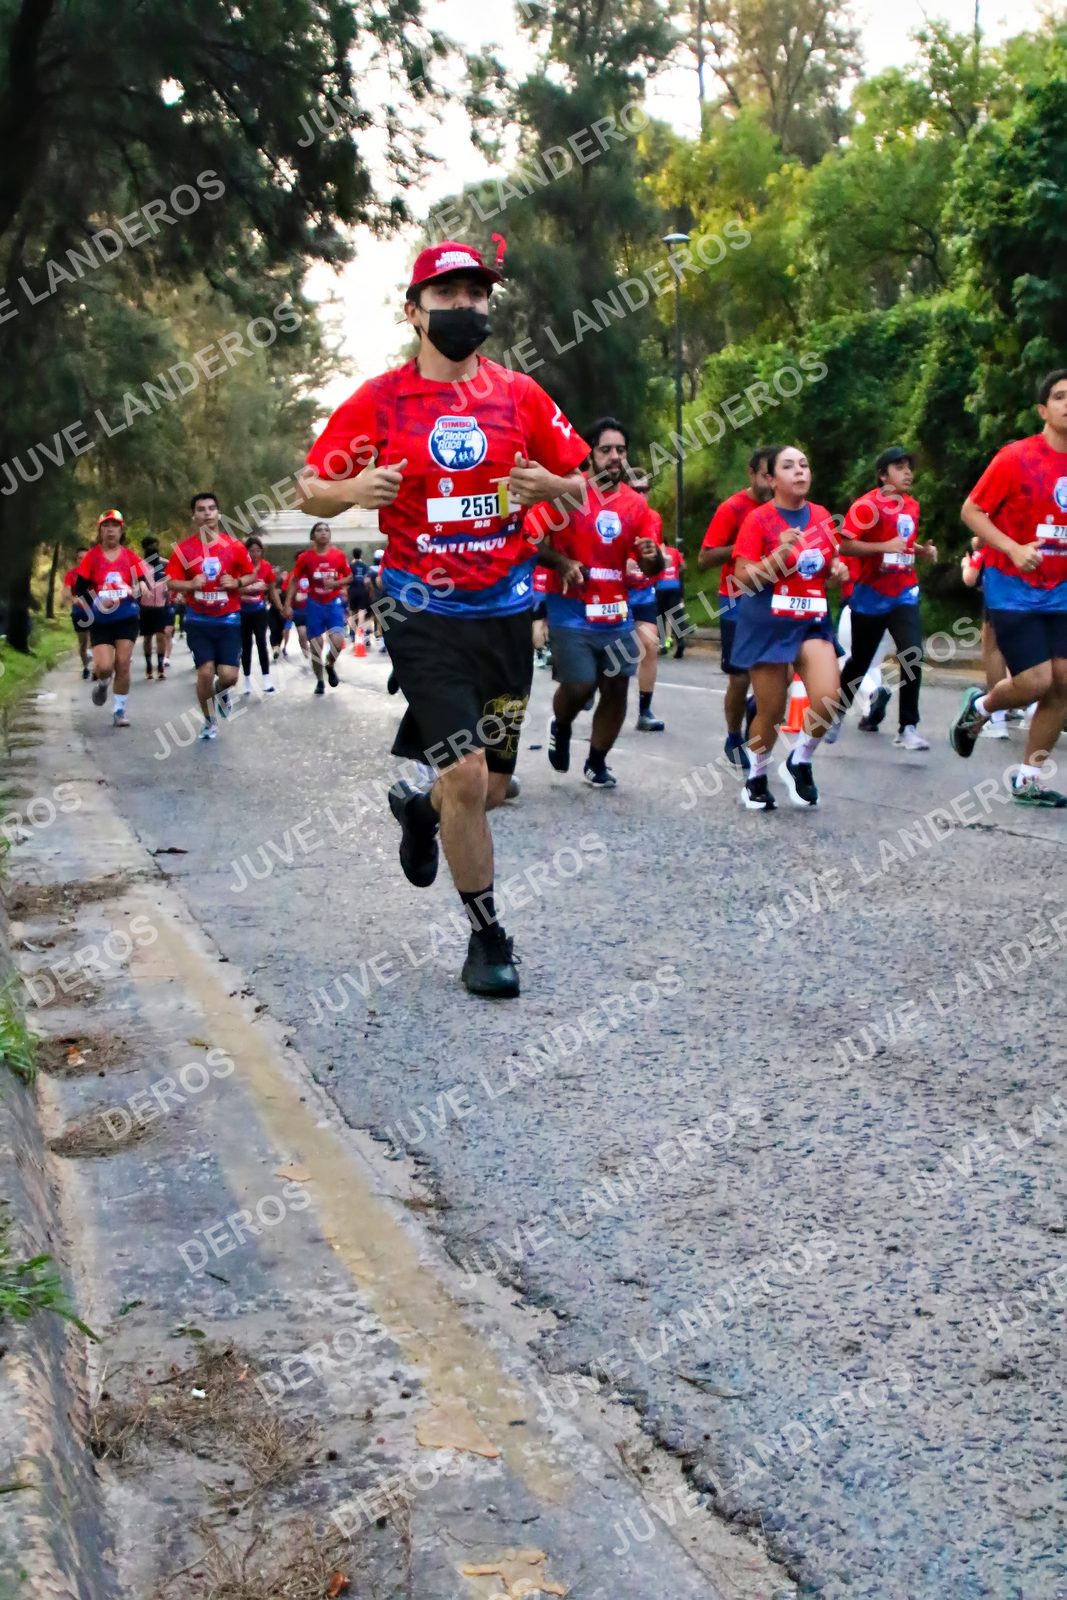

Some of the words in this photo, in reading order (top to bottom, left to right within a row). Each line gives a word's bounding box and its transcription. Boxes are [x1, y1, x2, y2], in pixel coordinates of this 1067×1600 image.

[441, 421, 472, 429] BIMBO
[443, 431, 473, 441] Global
[438, 440, 462, 450] Race
[461, 494, 500, 519] 2551
